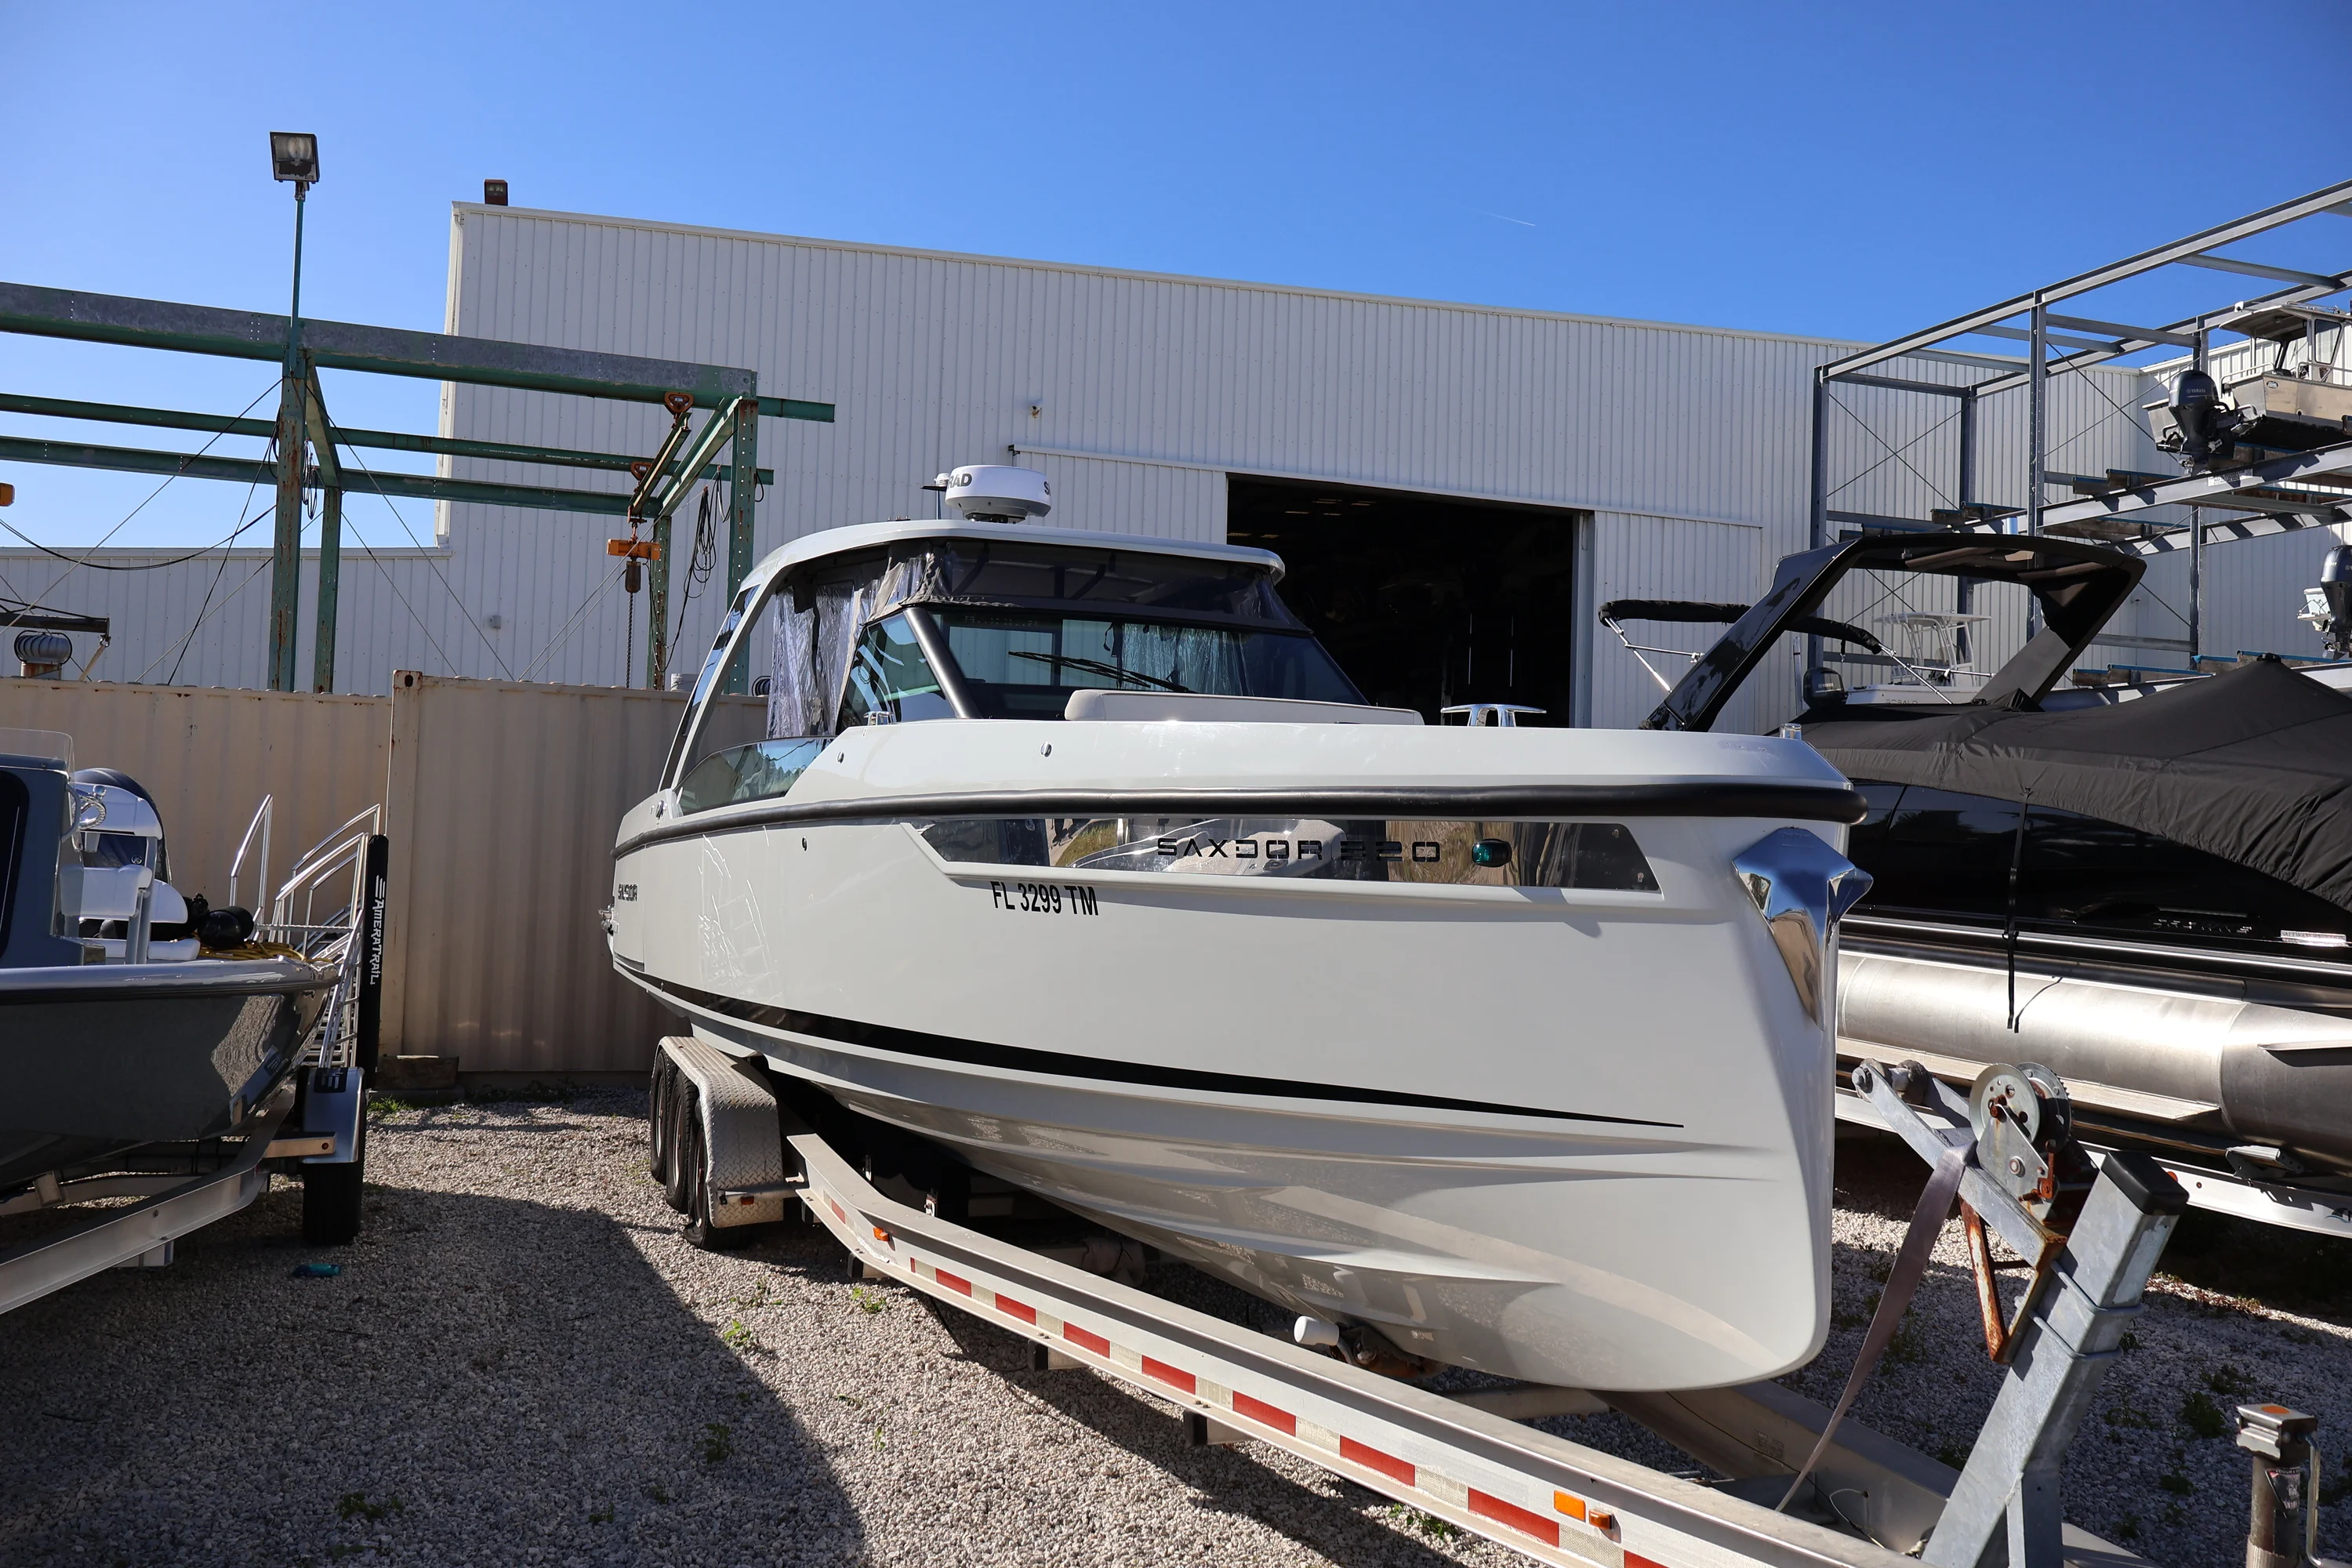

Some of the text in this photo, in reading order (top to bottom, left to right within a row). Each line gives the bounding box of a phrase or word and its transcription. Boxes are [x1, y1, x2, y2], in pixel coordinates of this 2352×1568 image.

[1157, 837, 1440, 862] SAXDOR 320
[990, 881, 1098, 916] FL 3299 TM
